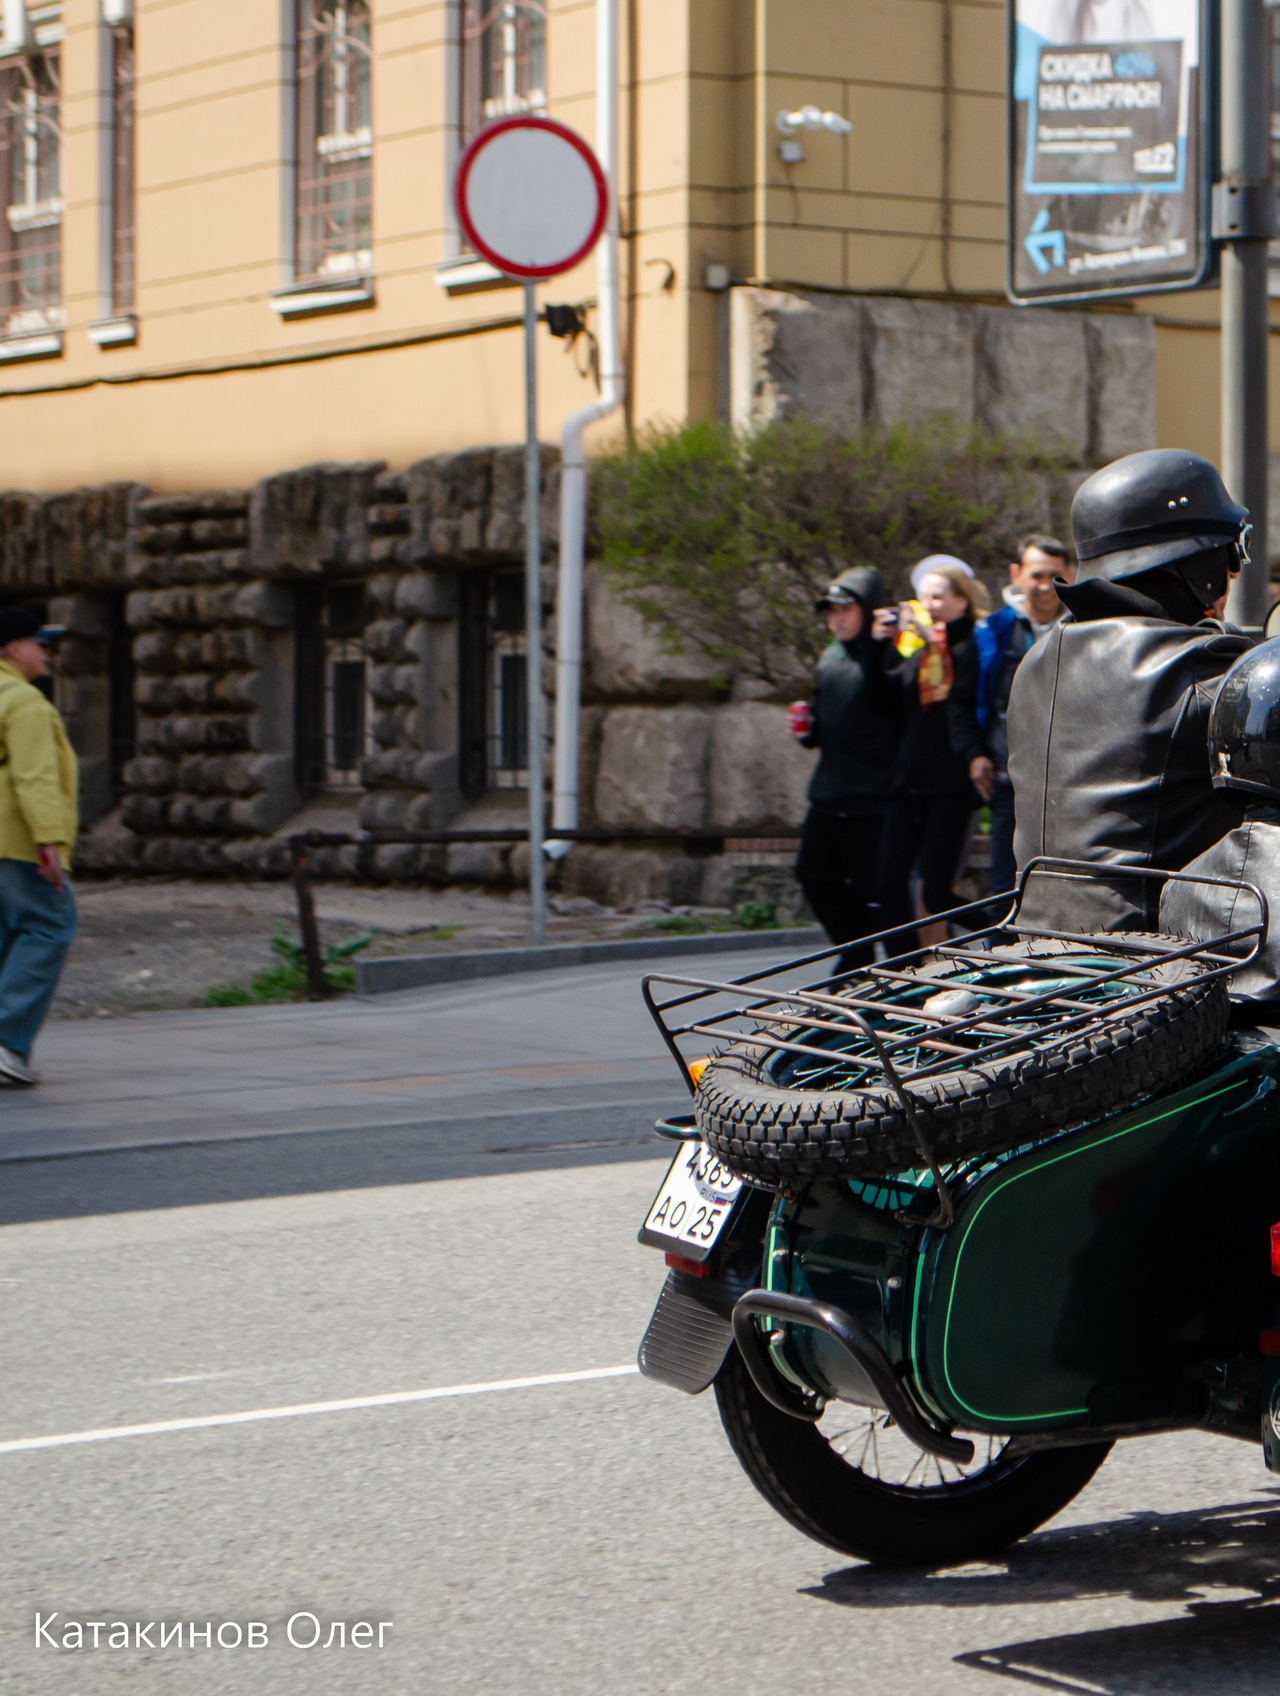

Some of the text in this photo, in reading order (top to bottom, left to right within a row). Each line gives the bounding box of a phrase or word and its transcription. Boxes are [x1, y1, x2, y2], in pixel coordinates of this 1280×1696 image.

[1040, 52, 1113, 82] СКИДКА
[1038, 81, 1162, 110] НА СМАРТФОН
[700, 1188, 717, 1203] RUS
[687, 1206, 721, 1241] 25
